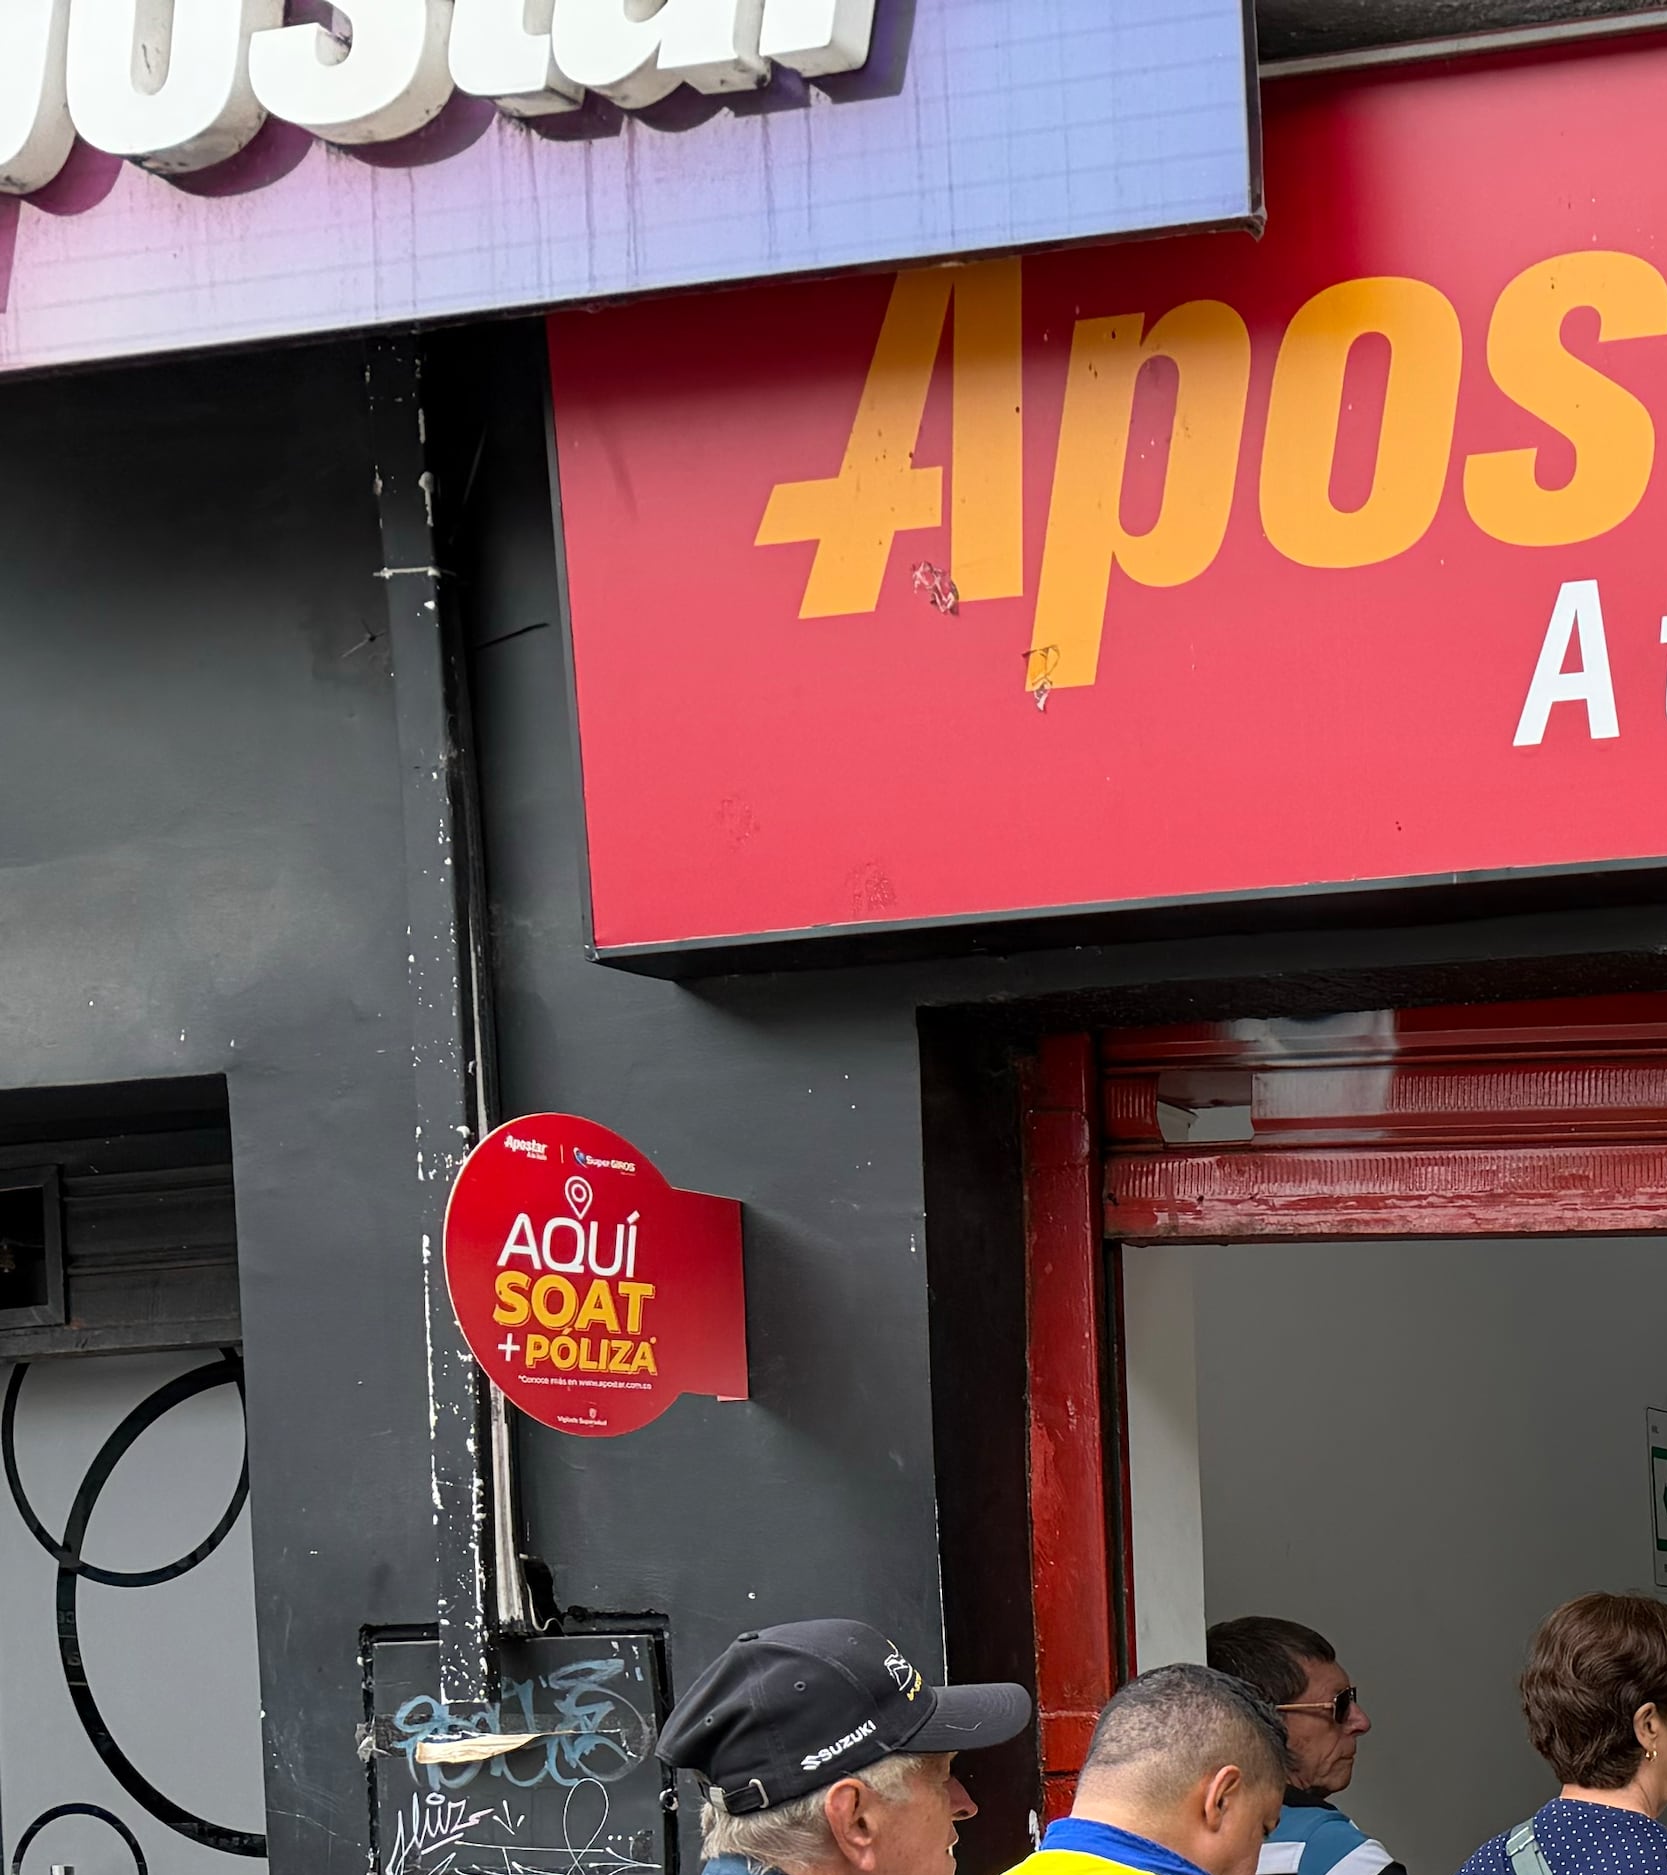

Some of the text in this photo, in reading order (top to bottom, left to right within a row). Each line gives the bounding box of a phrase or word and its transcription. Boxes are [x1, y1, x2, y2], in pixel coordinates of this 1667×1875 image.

[1513, 578, 1620, 747] A
[496, 1210, 641, 1278] AQUÍ
[492, 1270, 656, 1336] SOAT
[819, 1719, 876, 1763] SUZUKI
